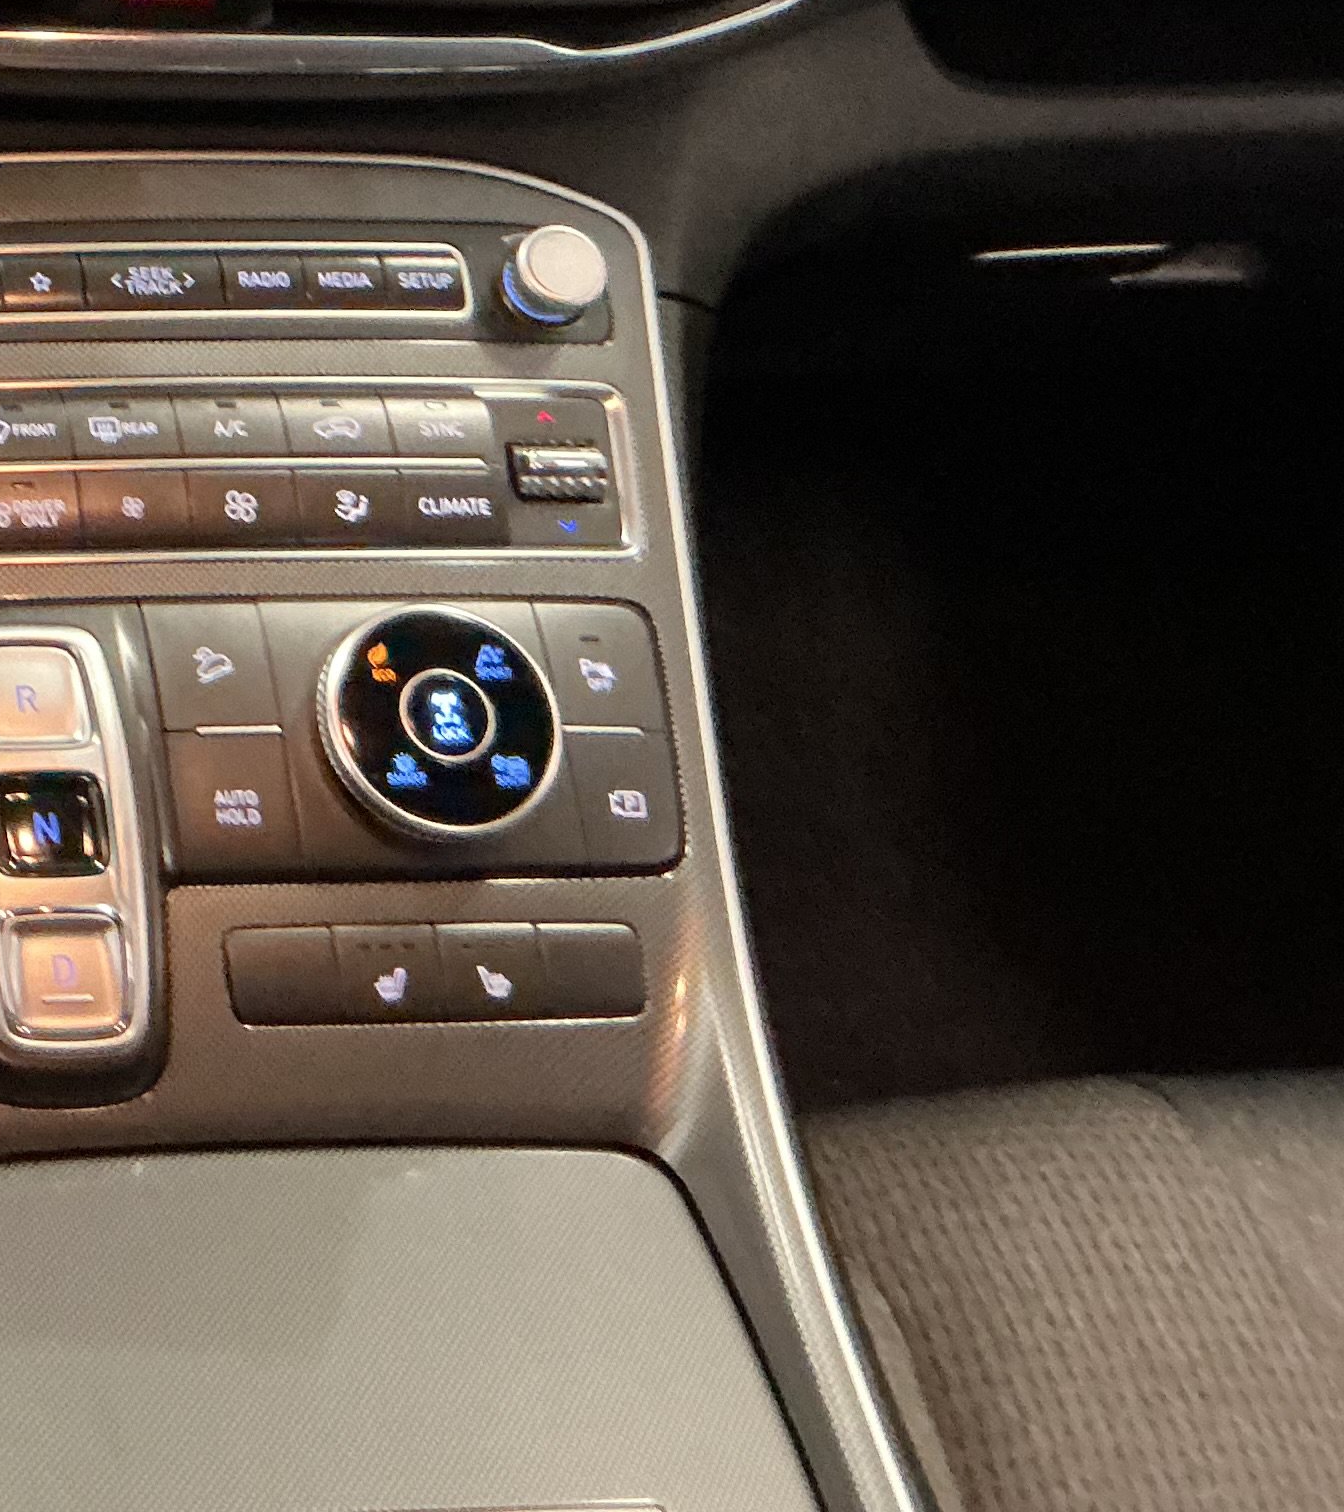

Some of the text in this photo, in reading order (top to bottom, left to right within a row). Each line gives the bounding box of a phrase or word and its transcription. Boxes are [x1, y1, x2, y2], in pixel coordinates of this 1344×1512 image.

[237, 270, 292, 289] RADIO
[317, 271, 374, 290] MEDIA
[398, 271, 455, 291] SETUP
[11, 422, 58, 439] FRONT
[213, 419, 250, 439] A/C
[418, 421, 466, 440] SYNC
[417, 495, 494, 519] CLIMATE
[15, 684, 39, 714] R
[214, 789, 260, 807] AUTO
[215, 807, 262, 826] HOLD
[32, 812, 62, 846] N
[53, 955, 75, 987] D
